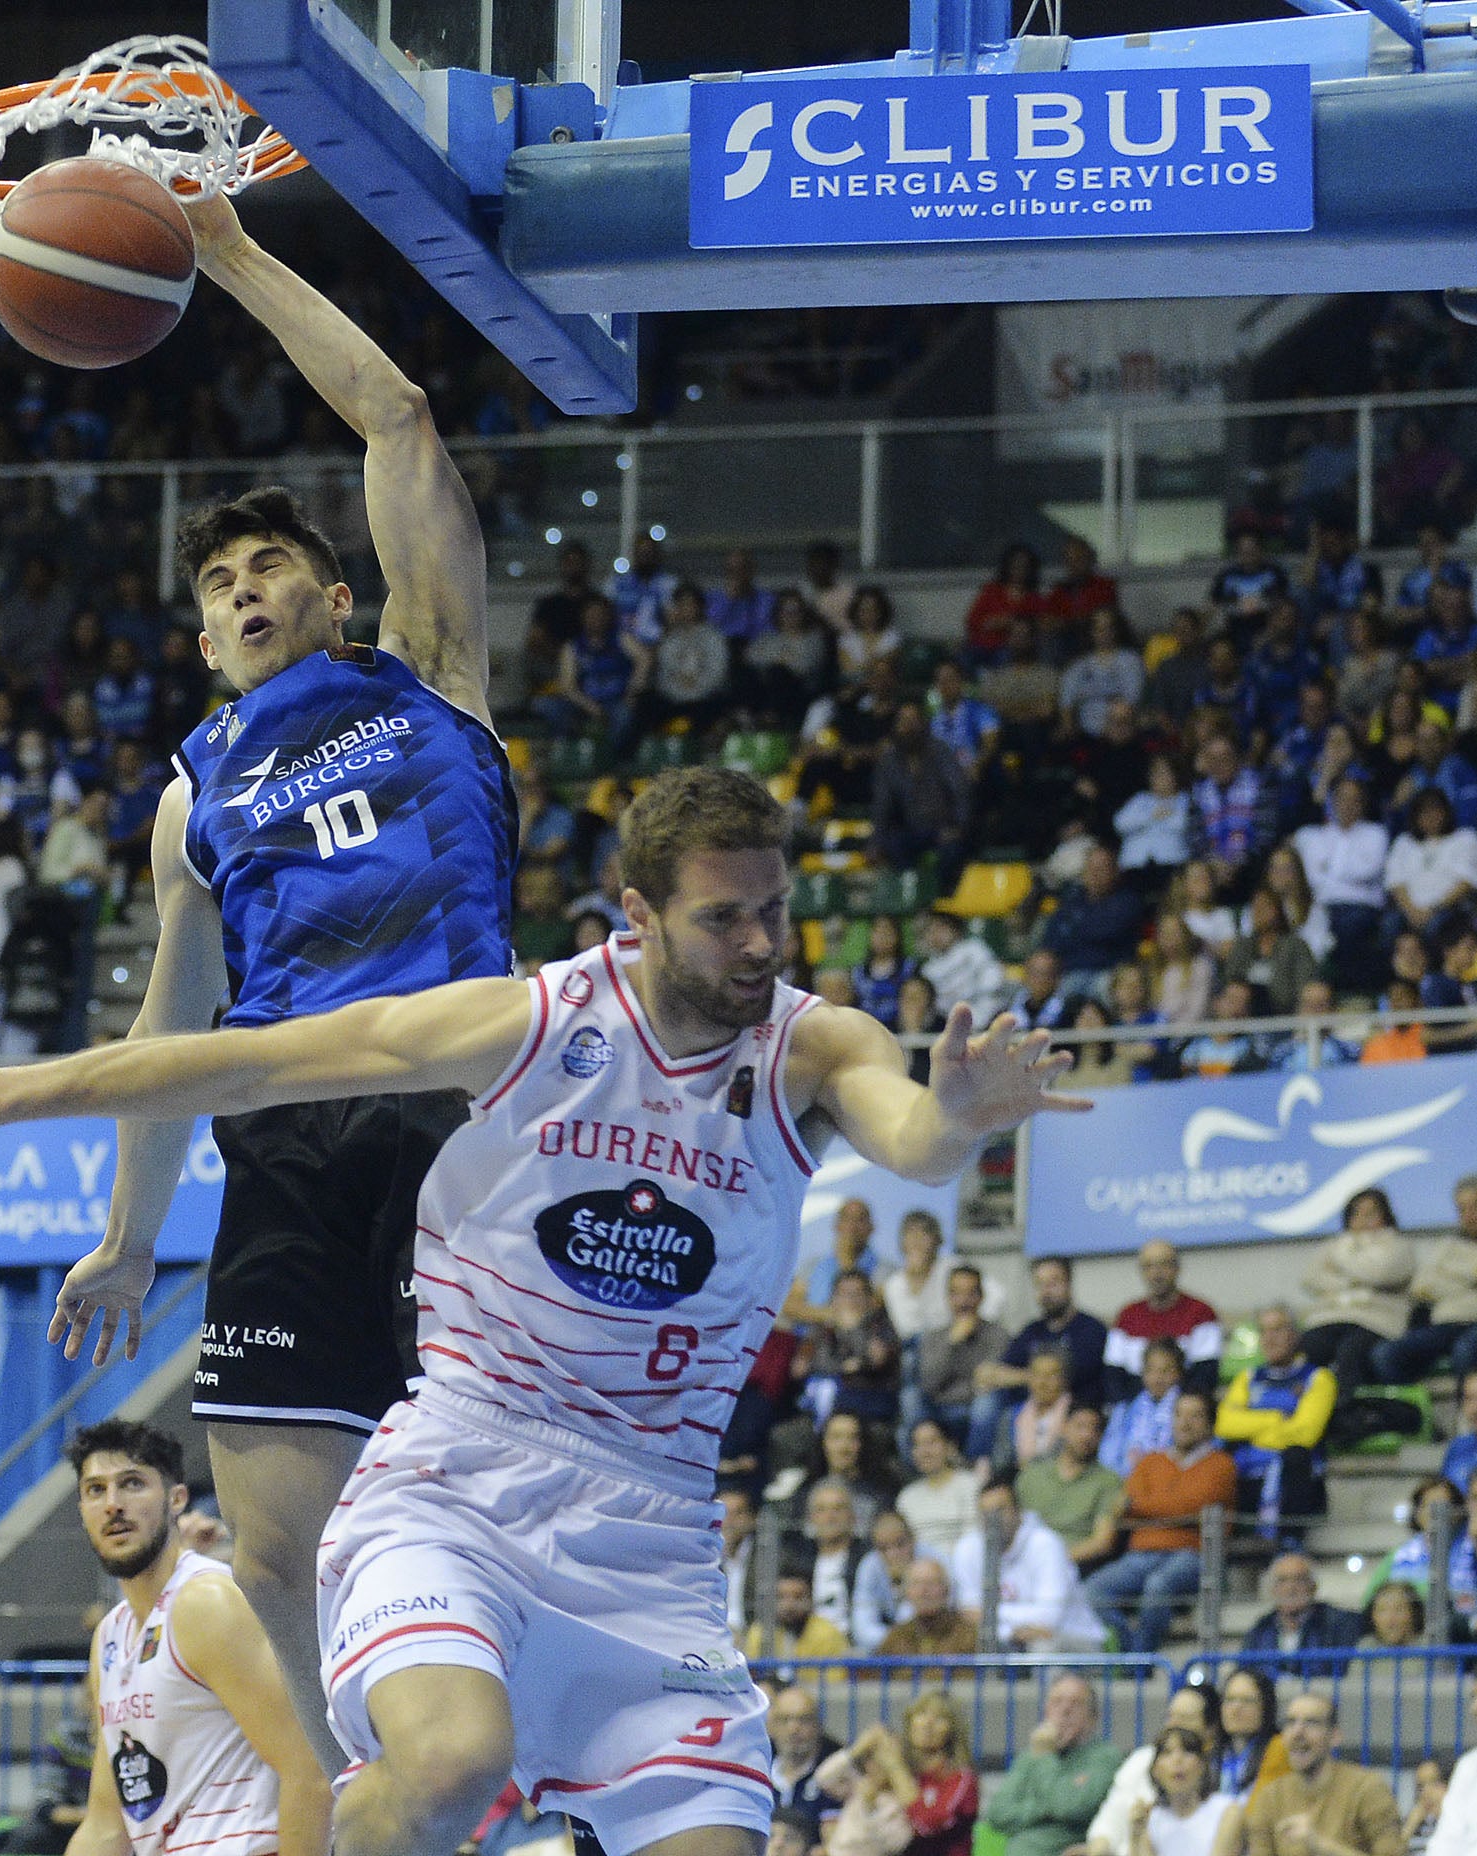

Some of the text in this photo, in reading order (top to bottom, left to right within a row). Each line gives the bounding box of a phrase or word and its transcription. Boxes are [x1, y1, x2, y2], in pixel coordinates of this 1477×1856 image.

[791, 85, 1275, 167] CLIBUR
[790, 161, 1278, 198] ENERGIAS Y SERVICIOS
[911, 197, 1154, 219] www.clibur.com
[206, 702, 234, 744] GIVO
[344, 728, 413, 757] INMOBILIARIA
[251, 748, 395, 828] BURGOS
[303, 790, 379, 860] 10
[70, 1141, 111, 1198] Y
[538, 1120, 754, 1193] OURENSE
[569, 1208, 694, 1255] Estrella
[566, 1233, 678, 1287] Galicia
[224, 1325, 237, 1345] Y
[243, 1326, 295, 1349] LEÓN
[348, 1596, 449, 1641] PERSAN
